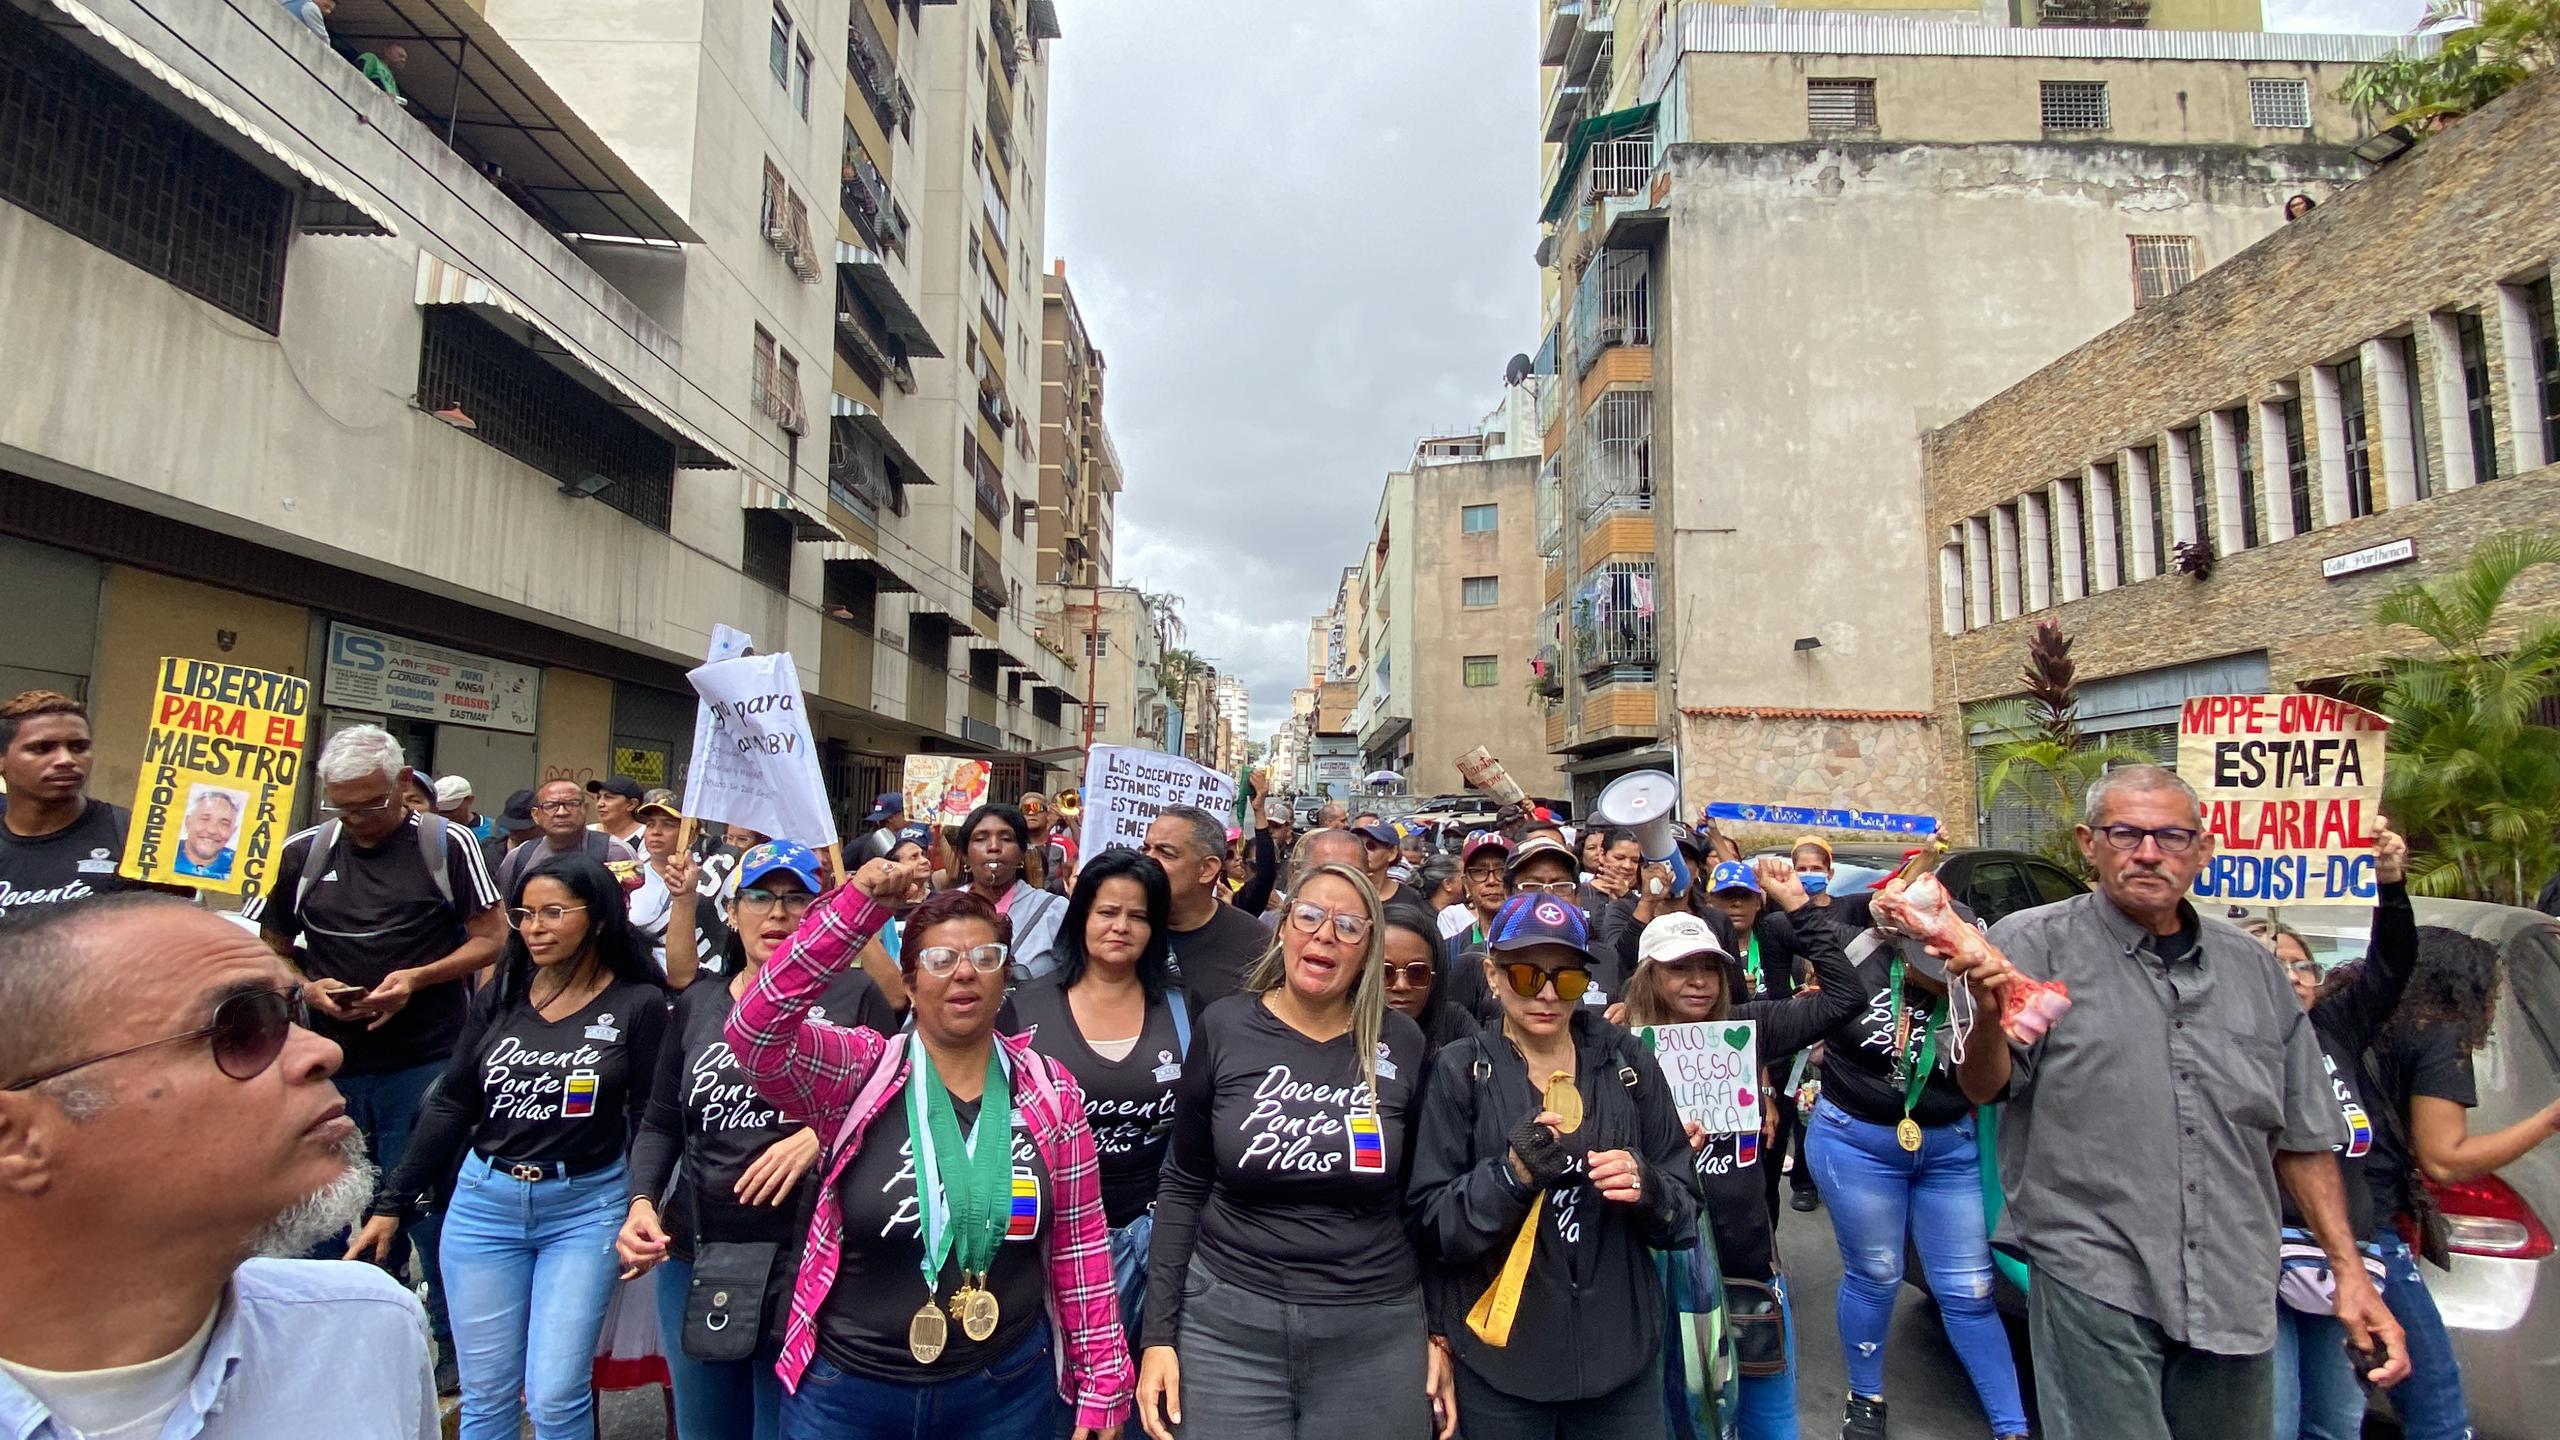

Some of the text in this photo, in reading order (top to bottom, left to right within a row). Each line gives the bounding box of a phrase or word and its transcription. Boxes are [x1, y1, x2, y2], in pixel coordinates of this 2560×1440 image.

[162, 657, 308, 715] LIBERTAD
[444, 693, 490, 711] PEGASUS
[159, 694, 304, 748] PARA EL
[449, 708, 488, 722] EASTMAN
[733, 693, 794, 728] para
[145, 727, 297, 786] MAESTRO
[2213, 739, 2364, 788] ESTAFA
[1104, 775, 1232, 812] ESTAMOS DE PARO
[1136, 764, 1193, 788] DOCENTES
[1198, 775, 1220, 792] NO
[137, 765, 177, 880] ROBERT
[241, 782, 279, 899] FRANCO
[486, 1036, 602, 1067] Docente
[1655, 1025, 1705, 1053] SOLO
[484, 1066, 562, 1094] Ponte
[1677, 1051, 1742, 1082] BESO
[1253, 1064, 1381, 1108] Docente
[489, 1093, 559, 1120] Pilas
[702, 1099, 775, 1132] Pilas
[1239, 1099, 1343, 1137] Ponte
[1237, 1132, 1342, 1173] Pilas
